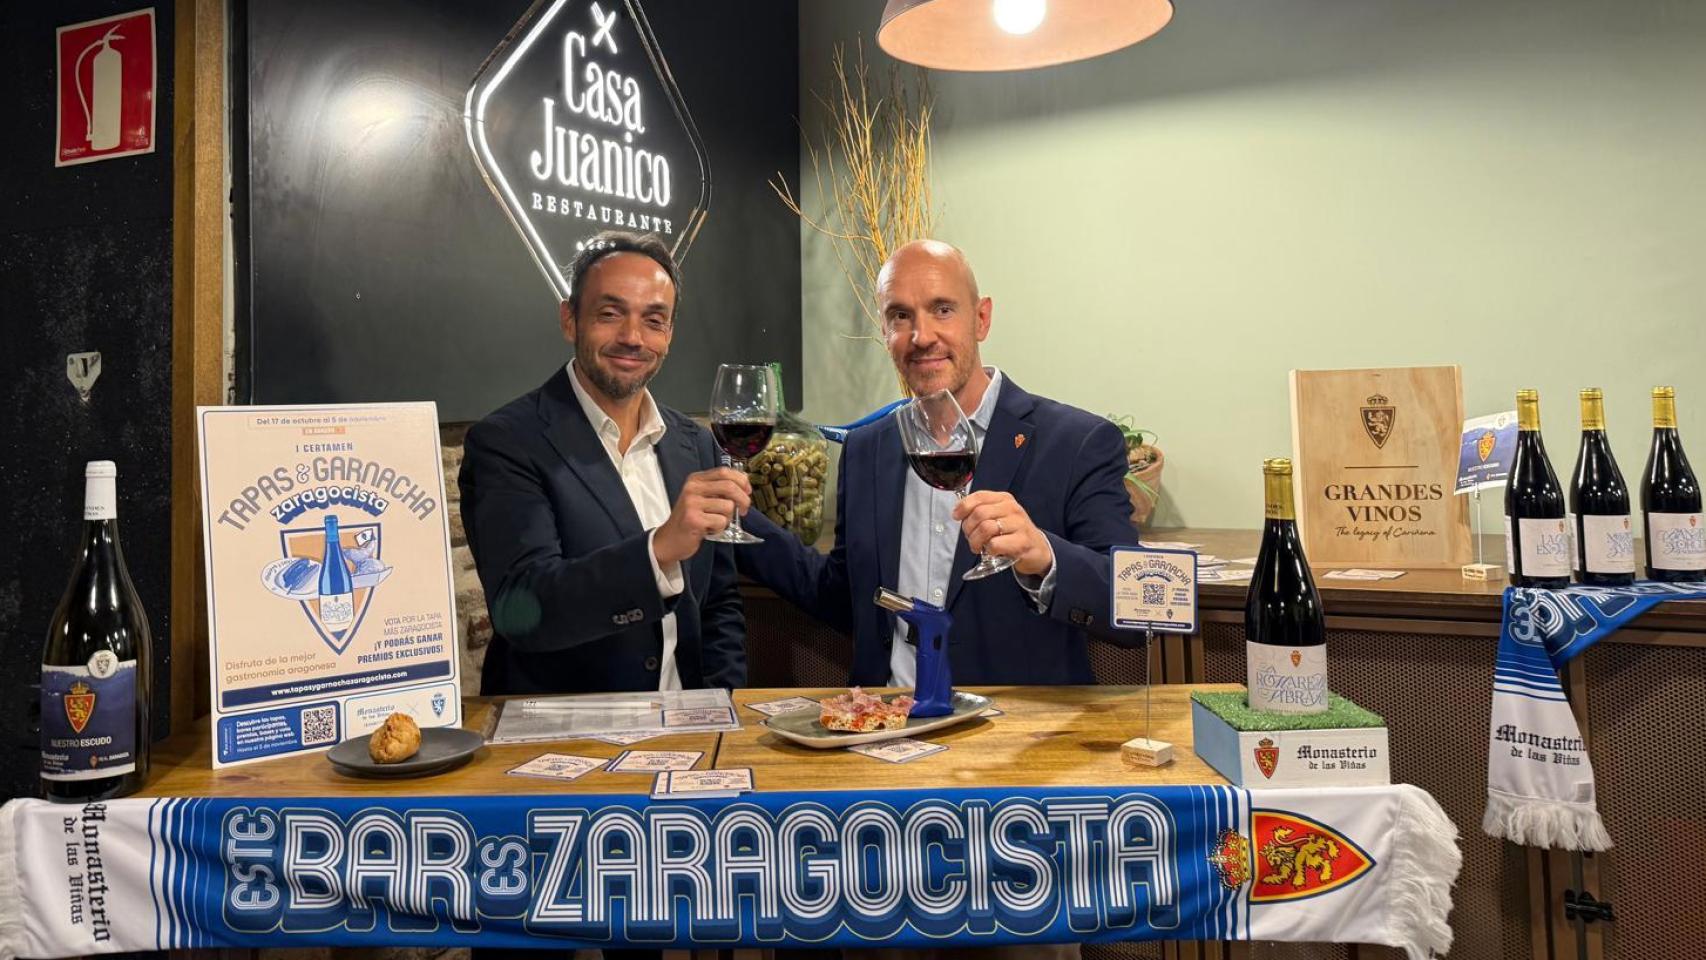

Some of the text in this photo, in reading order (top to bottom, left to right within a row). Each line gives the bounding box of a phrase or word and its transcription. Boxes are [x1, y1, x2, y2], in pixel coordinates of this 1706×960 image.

[564, 31, 645, 133] Casa
[530, 98, 671, 207] Juanico
[532, 192, 672, 234] RESTAURANTE
[292, 417, 321, 425] octubre
[303, 442, 353, 453] CERTAMEN
[217, 456, 436, 531] TAPAS & GARNACHA
[1324, 484, 1443, 500] GRANDES
[270, 485, 389, 522] zaragocista
[1346, 505, 1422, 522] VINOS
[1335, 526, 1350, 537] The
[1353, 526, 1381, 541] legacy
[1383, 525, 1393, 541] of
[1118, 561, 1143, 581] TAPAS
[1148, 559, 1192, 586] GARNACHA
[384, 617, 400, 626] VOTA
[402, 615, 415, 623] POR
[417, 614, 425, 622] LA
[384, 635, 415, 648] PODRÁS
[416, 632, 443, 643] GANAR
[225, 652, 316, 671] Disfruta de la mejor
[357, 645, 443, 664] PREMIOS EXCLUSIVOS!
[286, 661, 336, 675] aragonesa
[271, 671, 408, 696] www.tapasygarnachazaragocista.com
[51, 735, 112, 748] NUESTRO ESCUDO
[1494, 724, 1586, 751] Monasteri
[1297, 745, 1377, 759] Monasterio
[1510, 746, 1523, 758] de
[1528, 748, 1547, 762] las
[1309, 761, 1318, 769] de
[1322, 760, 1336, 769] las
[63, 816, 84, 925] de las Viñas
[228, 802, 1174, 923] ESTE BAR ES ZARAGOCISTA
